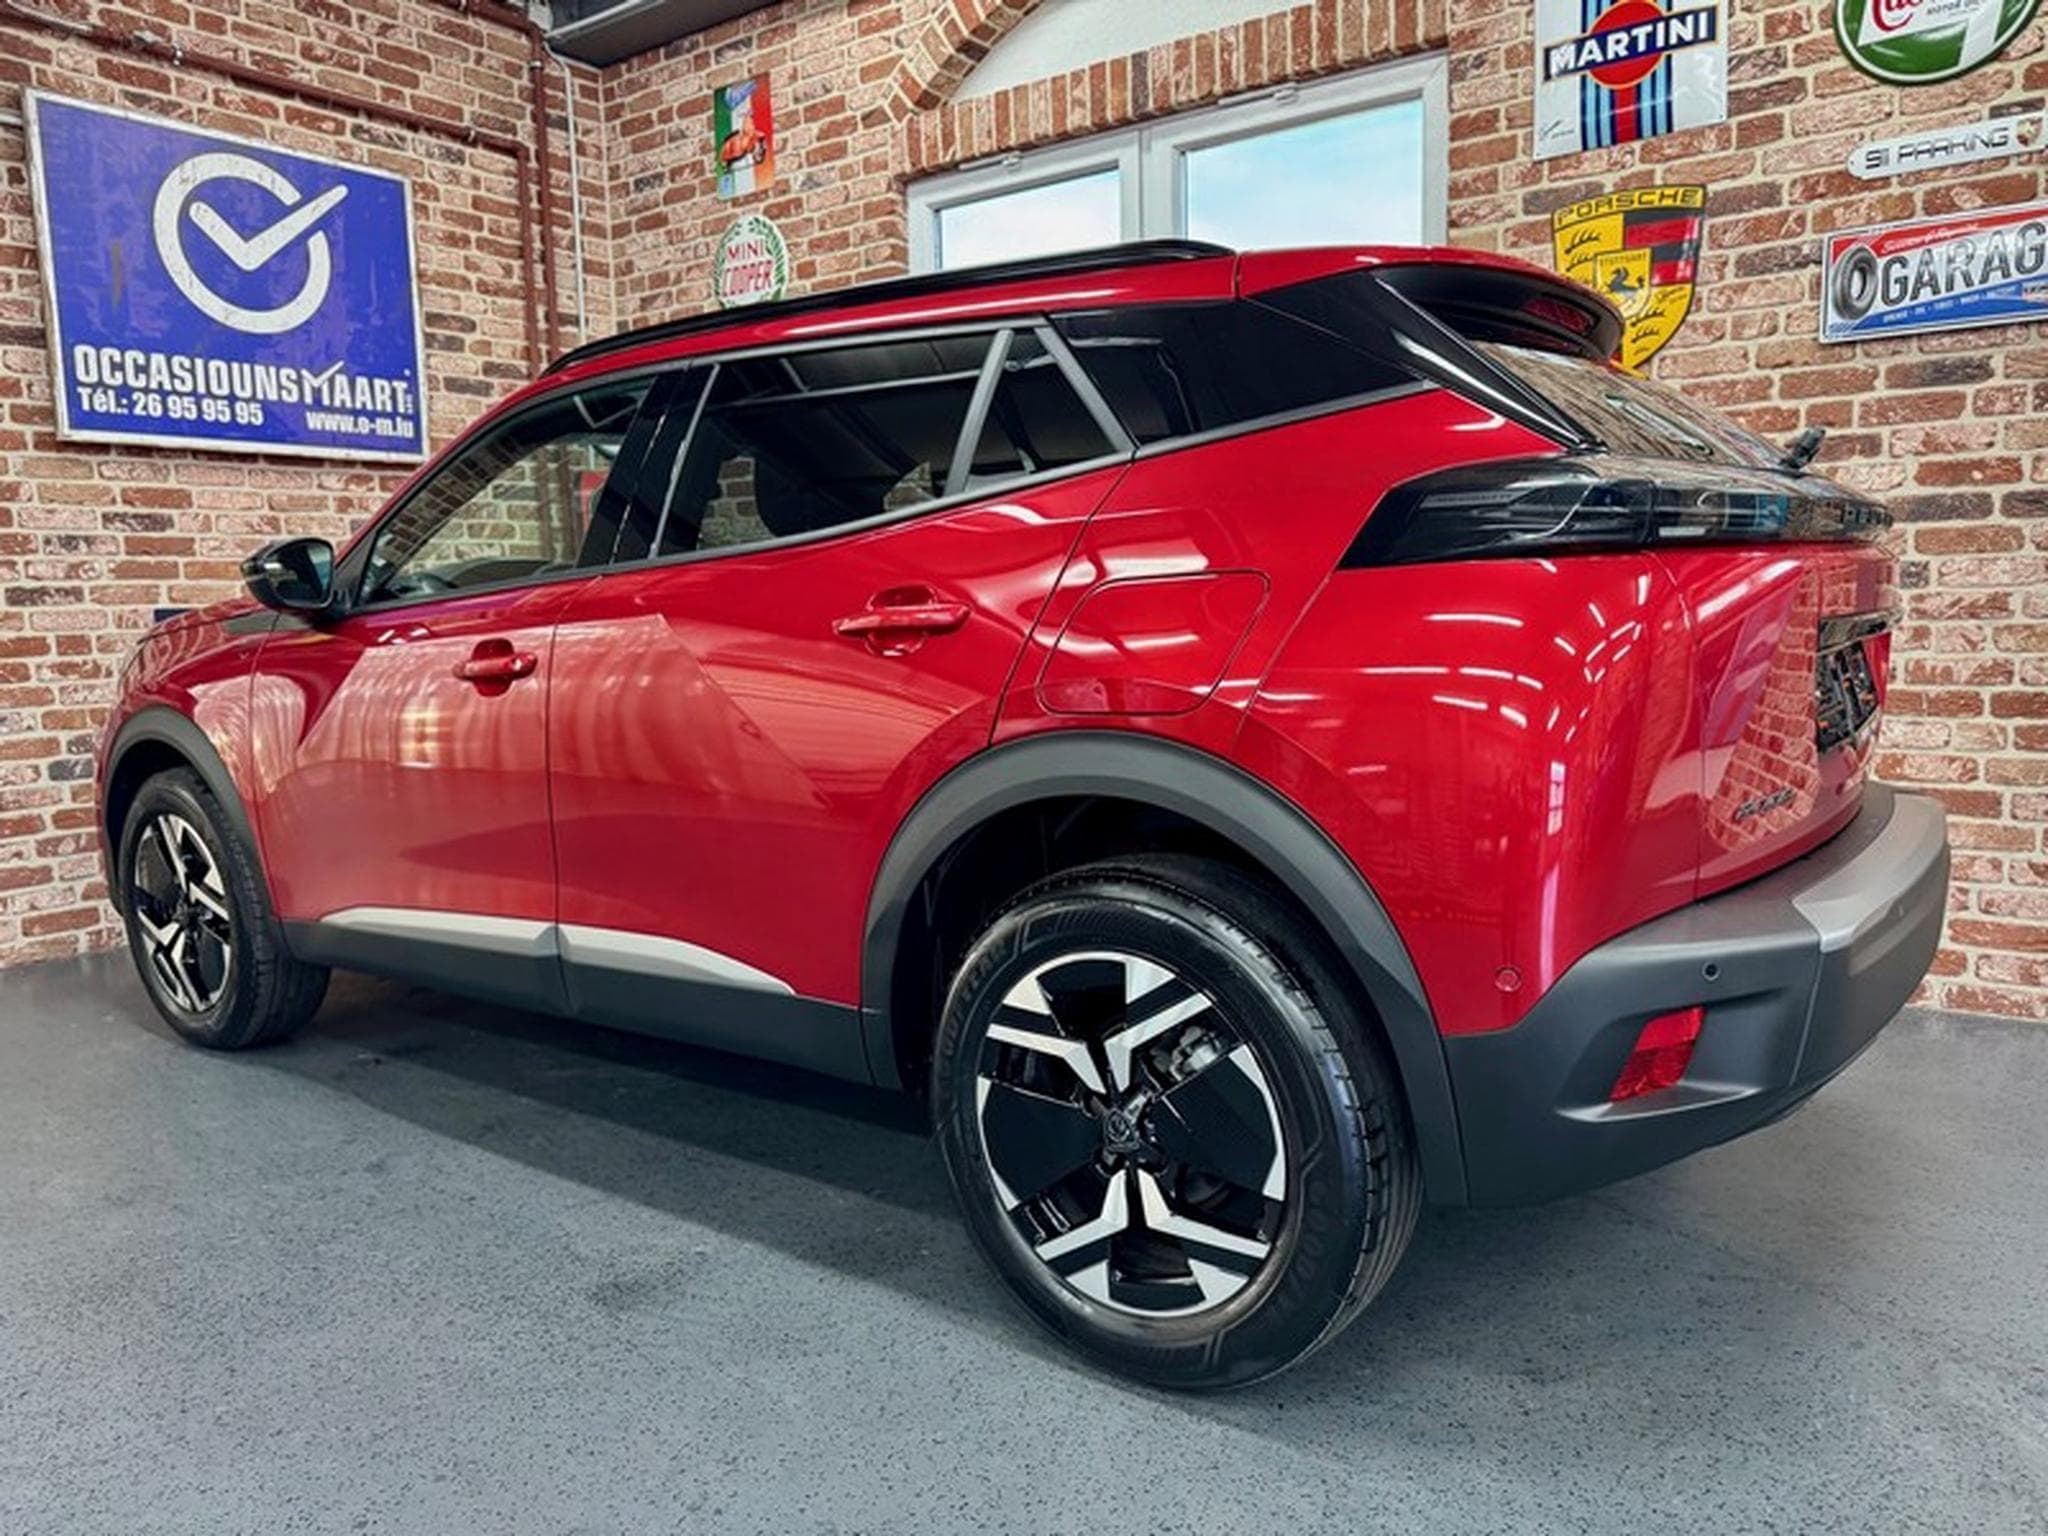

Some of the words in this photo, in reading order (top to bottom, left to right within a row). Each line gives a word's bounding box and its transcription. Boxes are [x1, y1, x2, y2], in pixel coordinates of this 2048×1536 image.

[1550, 11, 1709, 76] MARTINI
[1897, 126, 2010, 164] PARKING
[1557, 188, 1699, 226] PORSCHE
[727, 239, 764, 260] MINI
[1880, 221, 2047, 308] GARAG
[722, 259, 773, 297] COOPER
[131, 390, 163, 417] 26
[167, 394, 198, 421] 95
[201, 397, 232, 424] 95
[235, 400, 265, 427] 95
